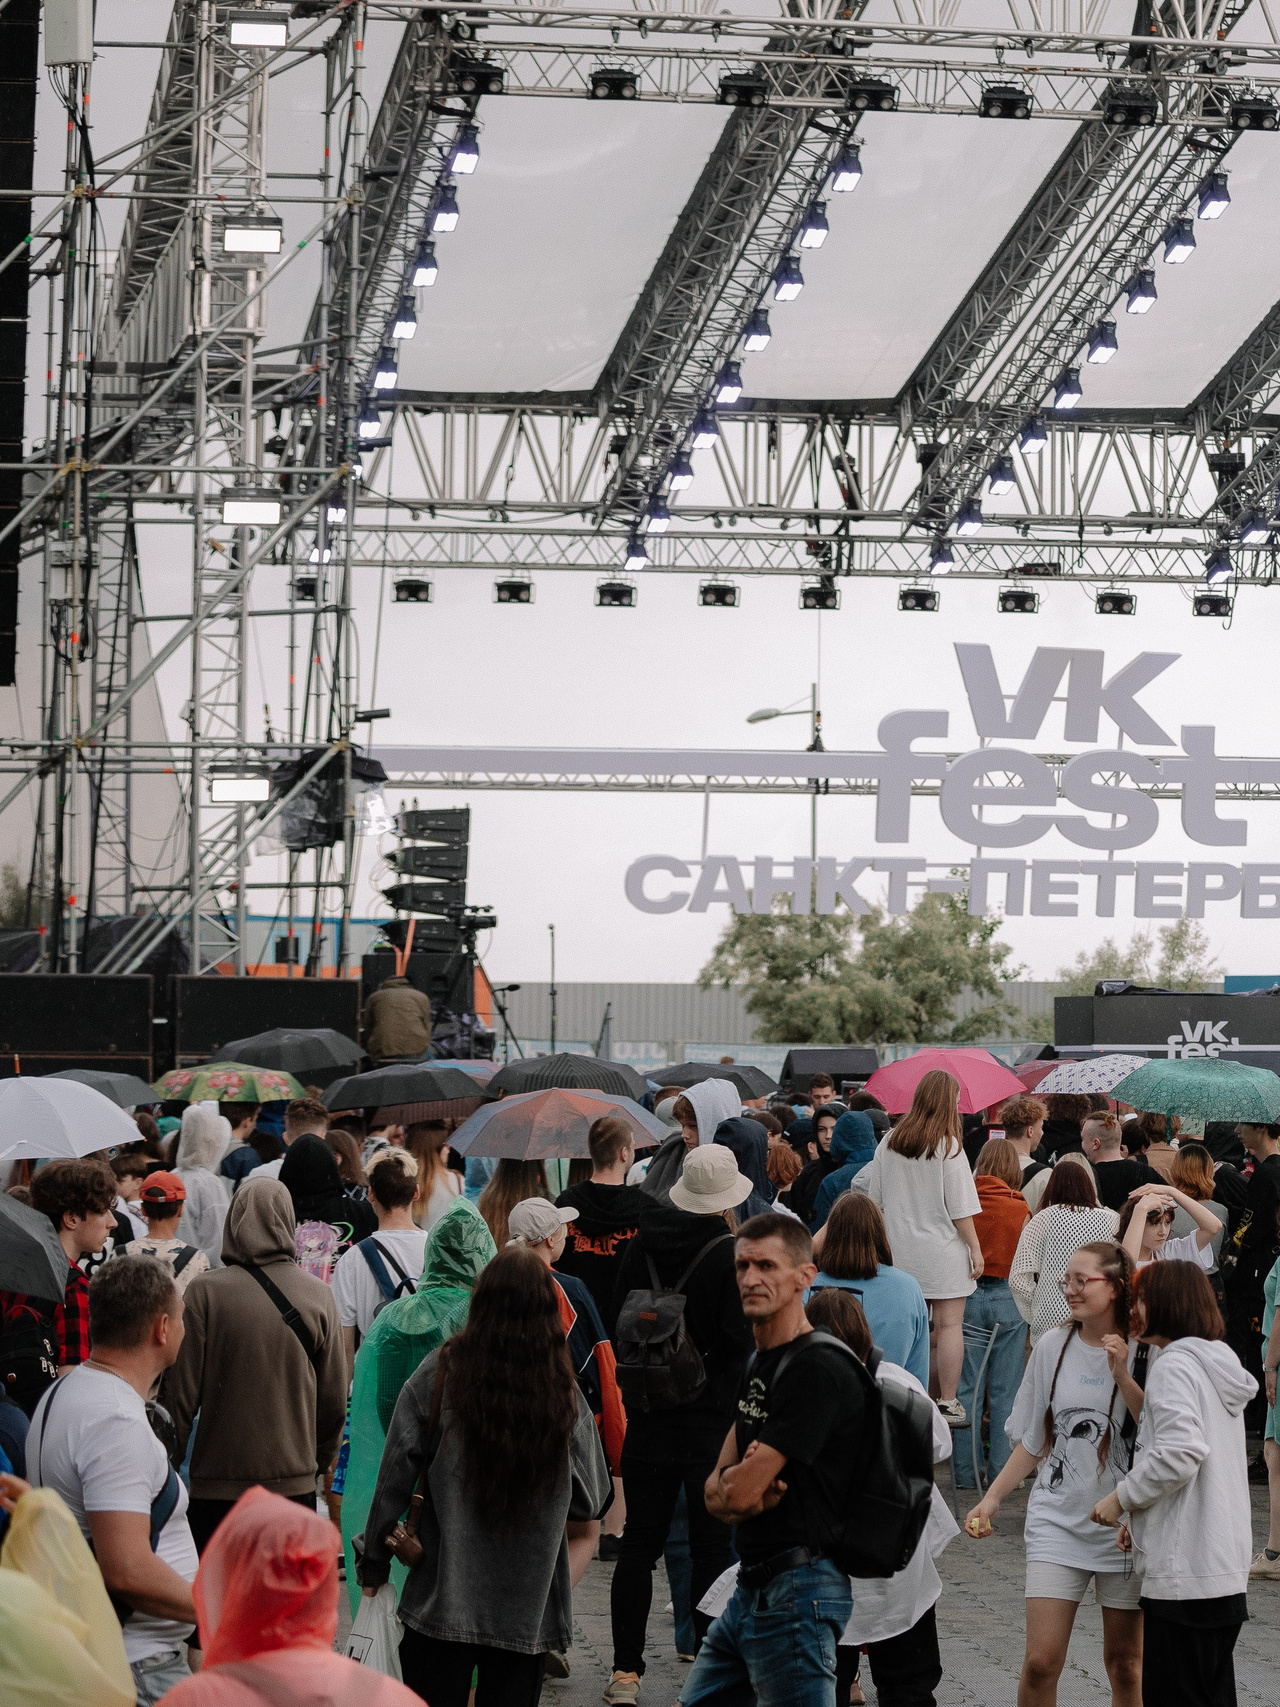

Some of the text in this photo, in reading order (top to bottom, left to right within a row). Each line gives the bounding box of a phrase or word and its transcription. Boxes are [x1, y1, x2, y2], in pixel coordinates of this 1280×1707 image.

[953, 642, 1182, 746] VK
[876, 708, 1248, 850] fest
[1180, 1020, 1229, 1042] VK
